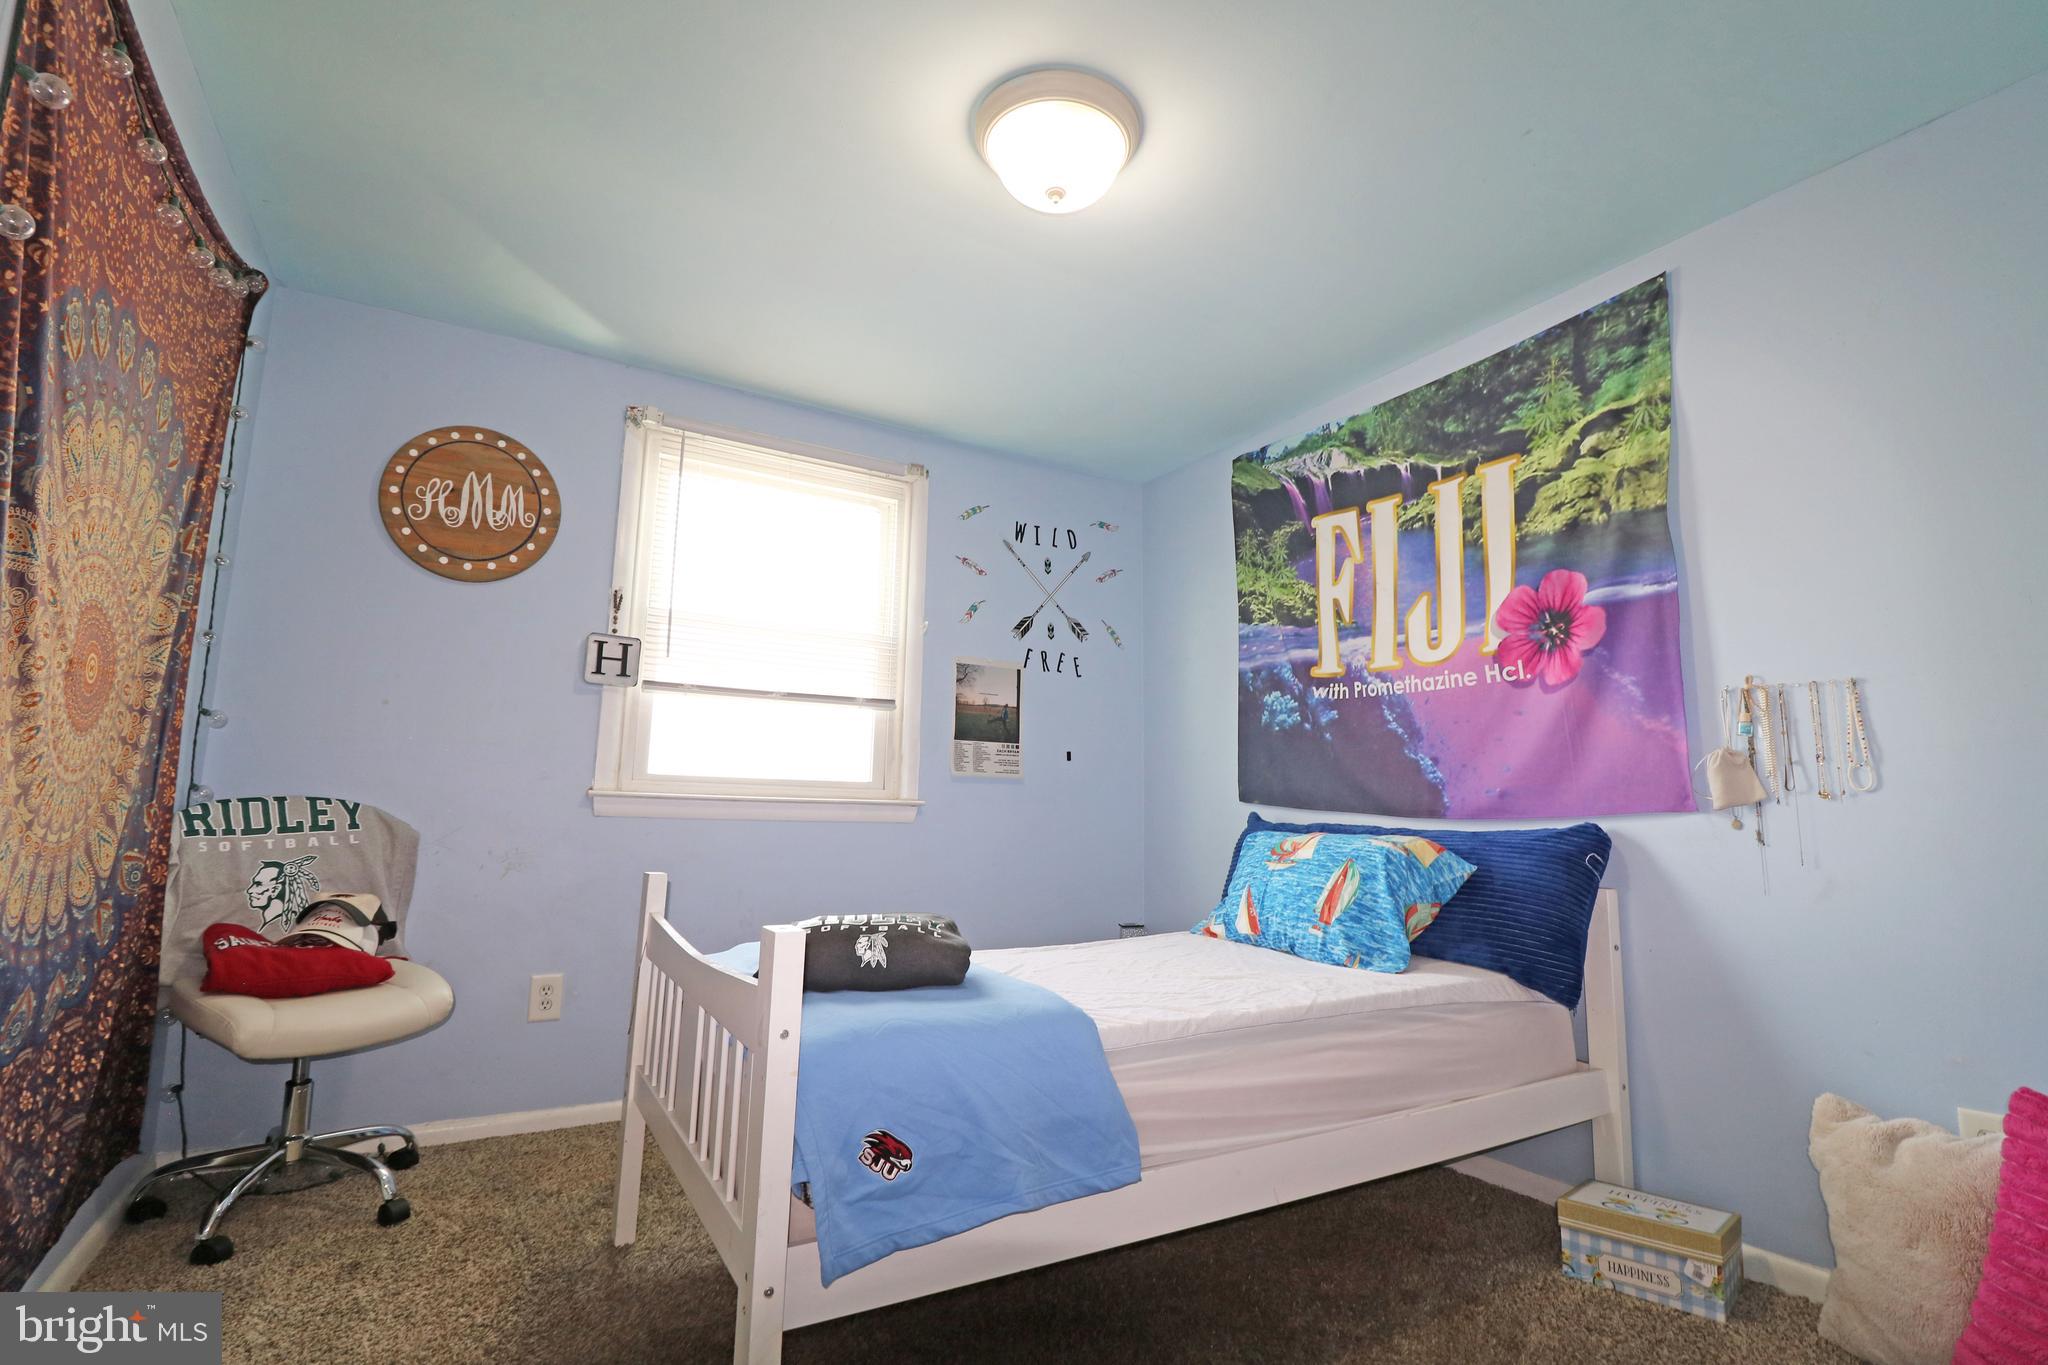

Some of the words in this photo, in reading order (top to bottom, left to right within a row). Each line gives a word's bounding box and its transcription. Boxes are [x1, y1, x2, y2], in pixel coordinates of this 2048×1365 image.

[1015, 521, 1077, 550] WILD
[1310, 453, 1521, 678] FIJI
[591, 640, 633, 677] H
[1023, 648, 1082, 678] FREE
[1312, 682, 1349, 700] with
[1354, 670, 1477, 698] Promethazine
[180, 796, 361, 838] RIDLEY
[199, 834, 361, 852] SOFTBALL
[860, 1147, 899, 1180] SJU
[1607, 1260, 1670, 1289] HAPPINESS
